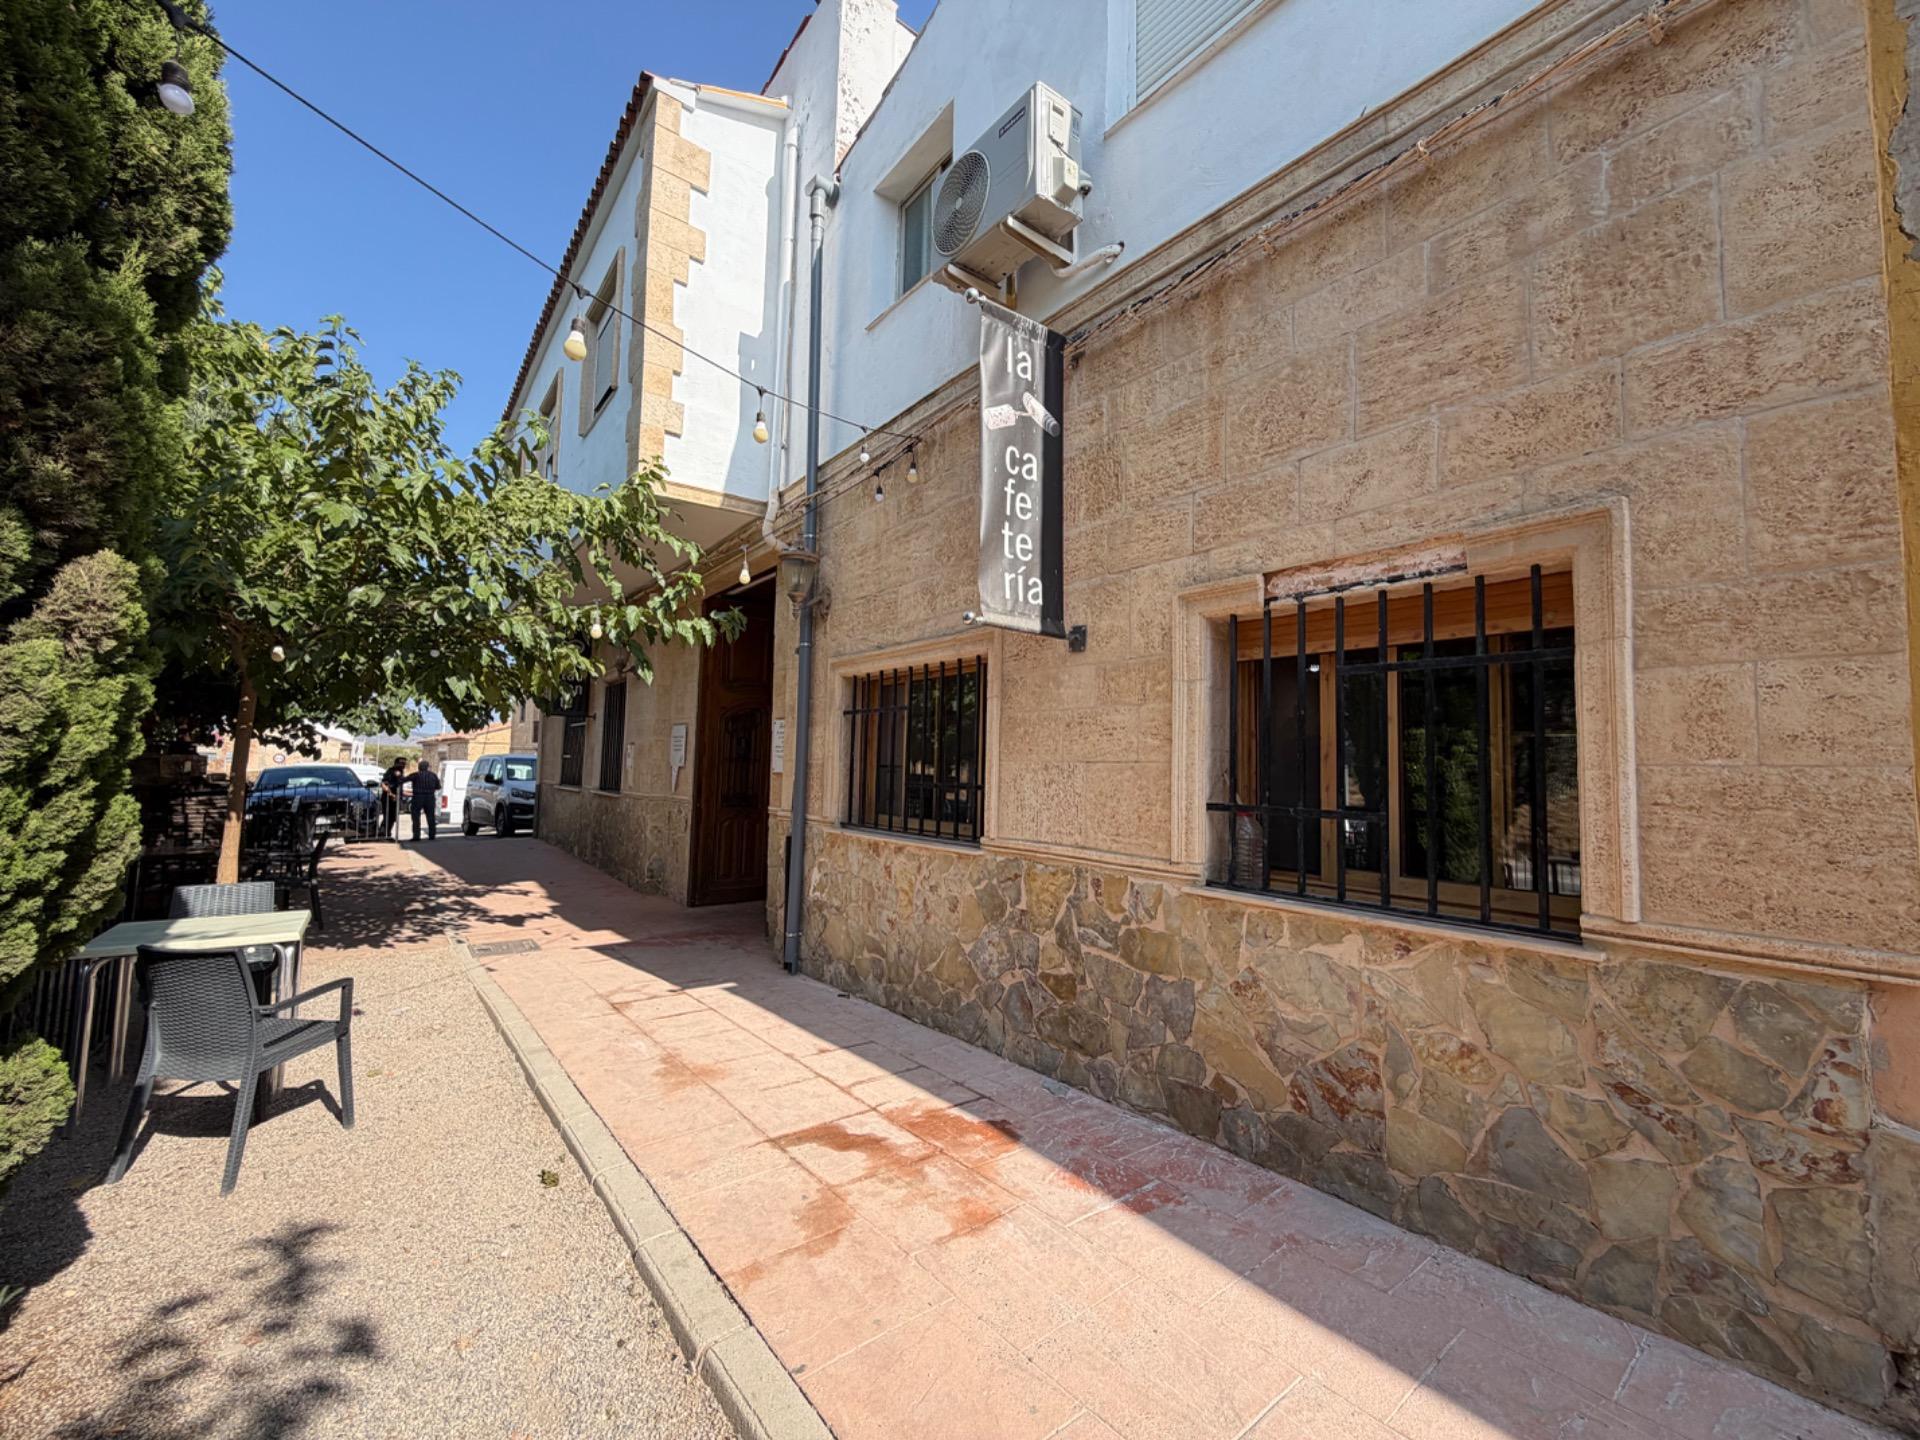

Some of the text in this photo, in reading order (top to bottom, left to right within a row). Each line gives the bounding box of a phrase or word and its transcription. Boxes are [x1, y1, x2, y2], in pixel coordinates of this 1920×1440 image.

[1007, 336, 1032, 381] la
[1005, 445, 1038, 482] ca
[1004, 478, 1032, 520] fe
[1001, 520, 1033, 562] te
